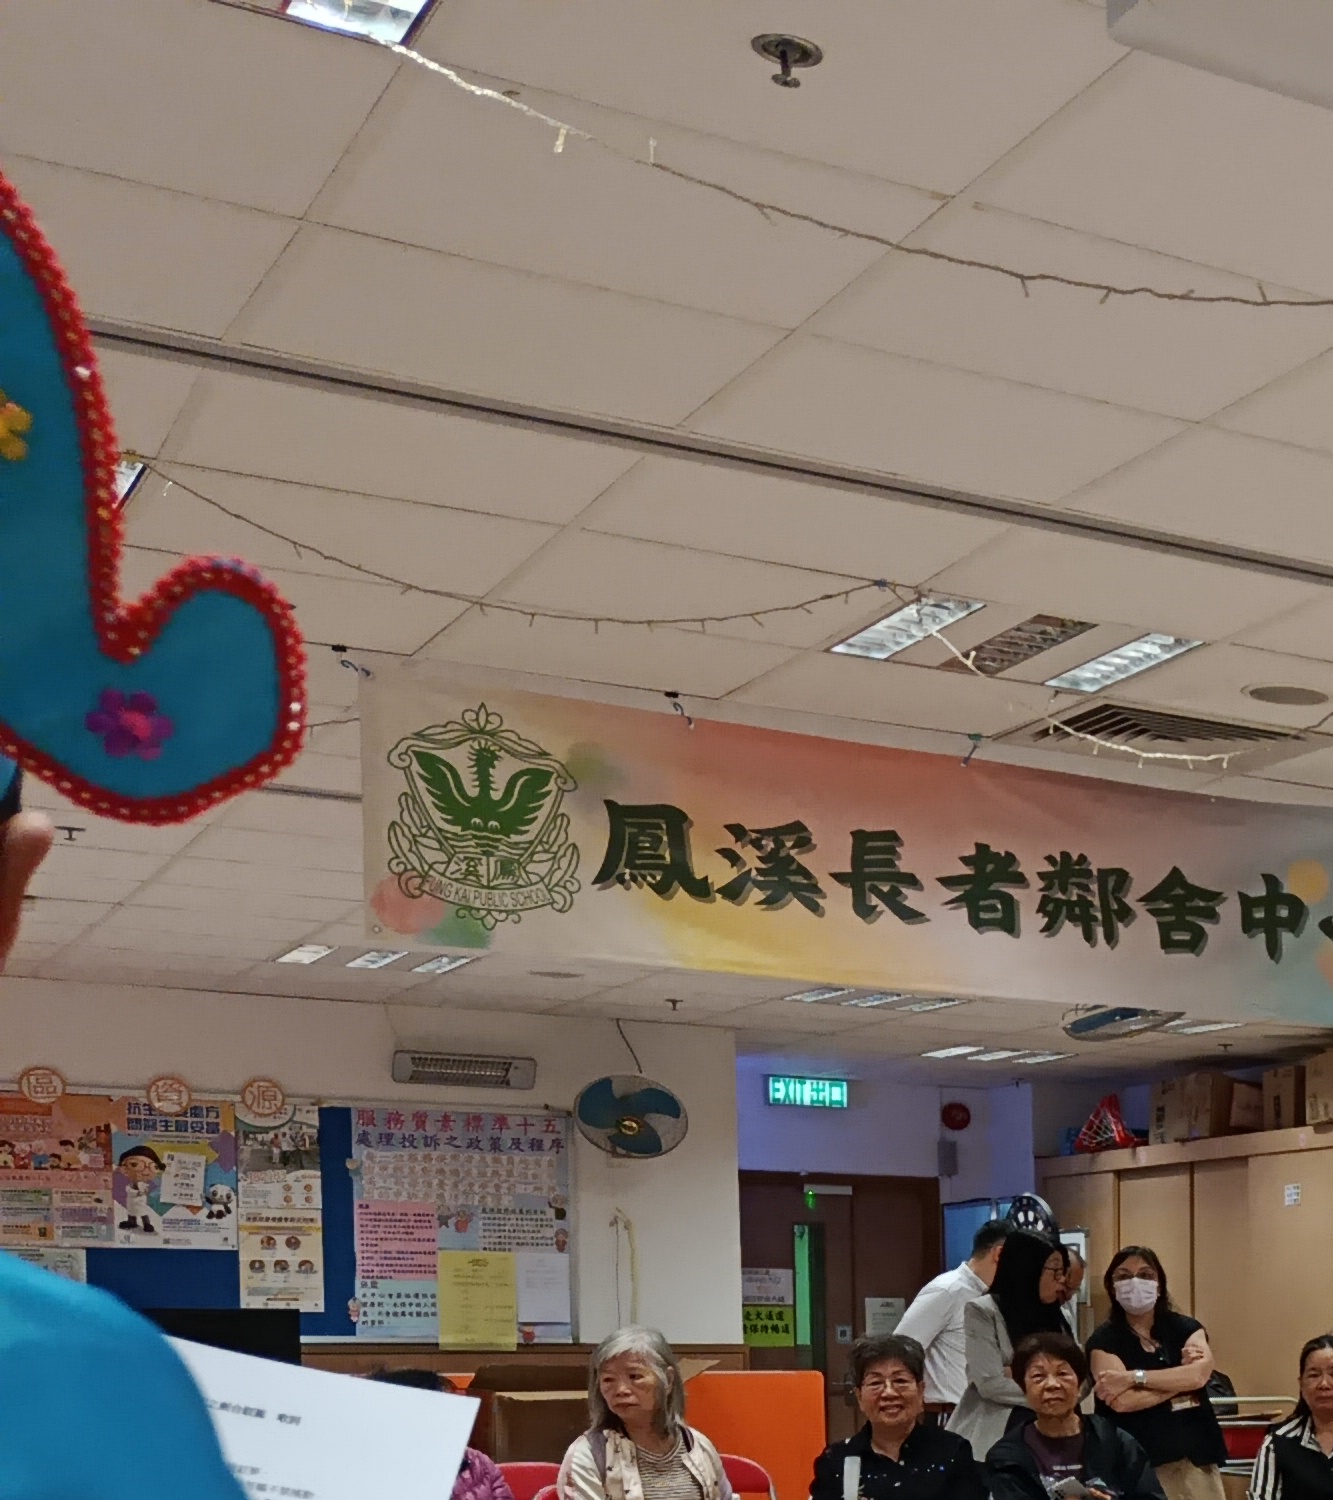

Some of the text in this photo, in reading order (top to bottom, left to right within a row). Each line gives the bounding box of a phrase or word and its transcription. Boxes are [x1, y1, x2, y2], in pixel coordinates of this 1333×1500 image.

[454, 887, 471, 903] KAI
[474, 889, 509, 909] PUBLIC
[252, 1086, 278, 1111] 源
[772, 1078, 844, 1107] EXIT 出口
[127, 1102, 220, 1119] 抗生處方
[356, 1109, 562, 1136] 服務質素標準十五
[355, 1129, 565, 1155] 處理投訴之政策及程序
